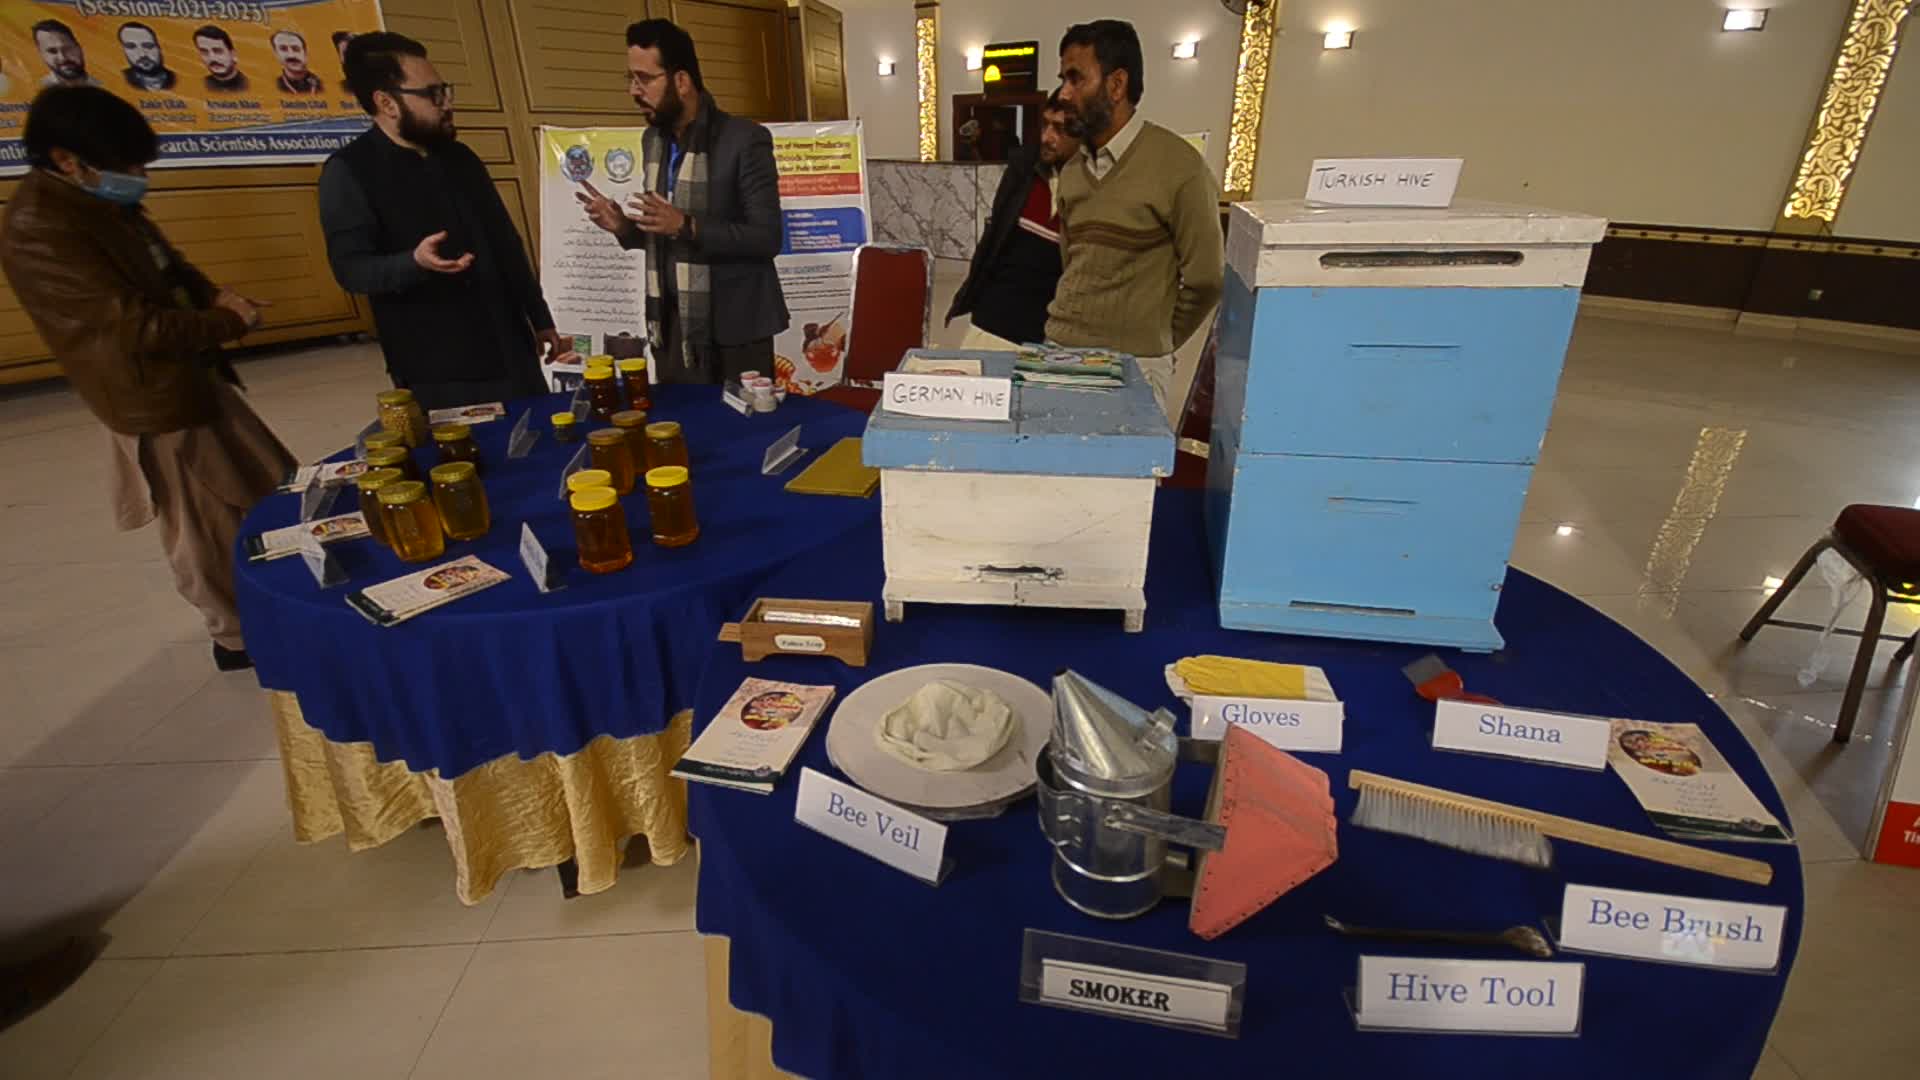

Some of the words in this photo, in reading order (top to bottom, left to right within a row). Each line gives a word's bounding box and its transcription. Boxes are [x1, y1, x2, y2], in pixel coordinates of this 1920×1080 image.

[159, 137, 200, 153] earch
[200, 135, 268, 153] Scientists
[269, 134, 340, 150] Association
[1315, 166, 1386, 190] TURKISH
[1397, 172, 1434, 188] HIVE
[892, 382, 964, 404] GERMAN
[973, 391, 1005, 407] HIVE
[1222, 703, 1301, 728] Gloves
[1479, 712, 1563, 744] Shana
[827, 790, 868, 829] Bee
[875, 811, 921, 852] Veil
[1588, 897, 1650, 931] Bee
[1661, 906, 1764, 944] Brush
[1069, 977, 1172, 1013] SMOKER
[1387, 971, 1469, 1005] Hive
[1480, 976, 1557, 1008] Tool
